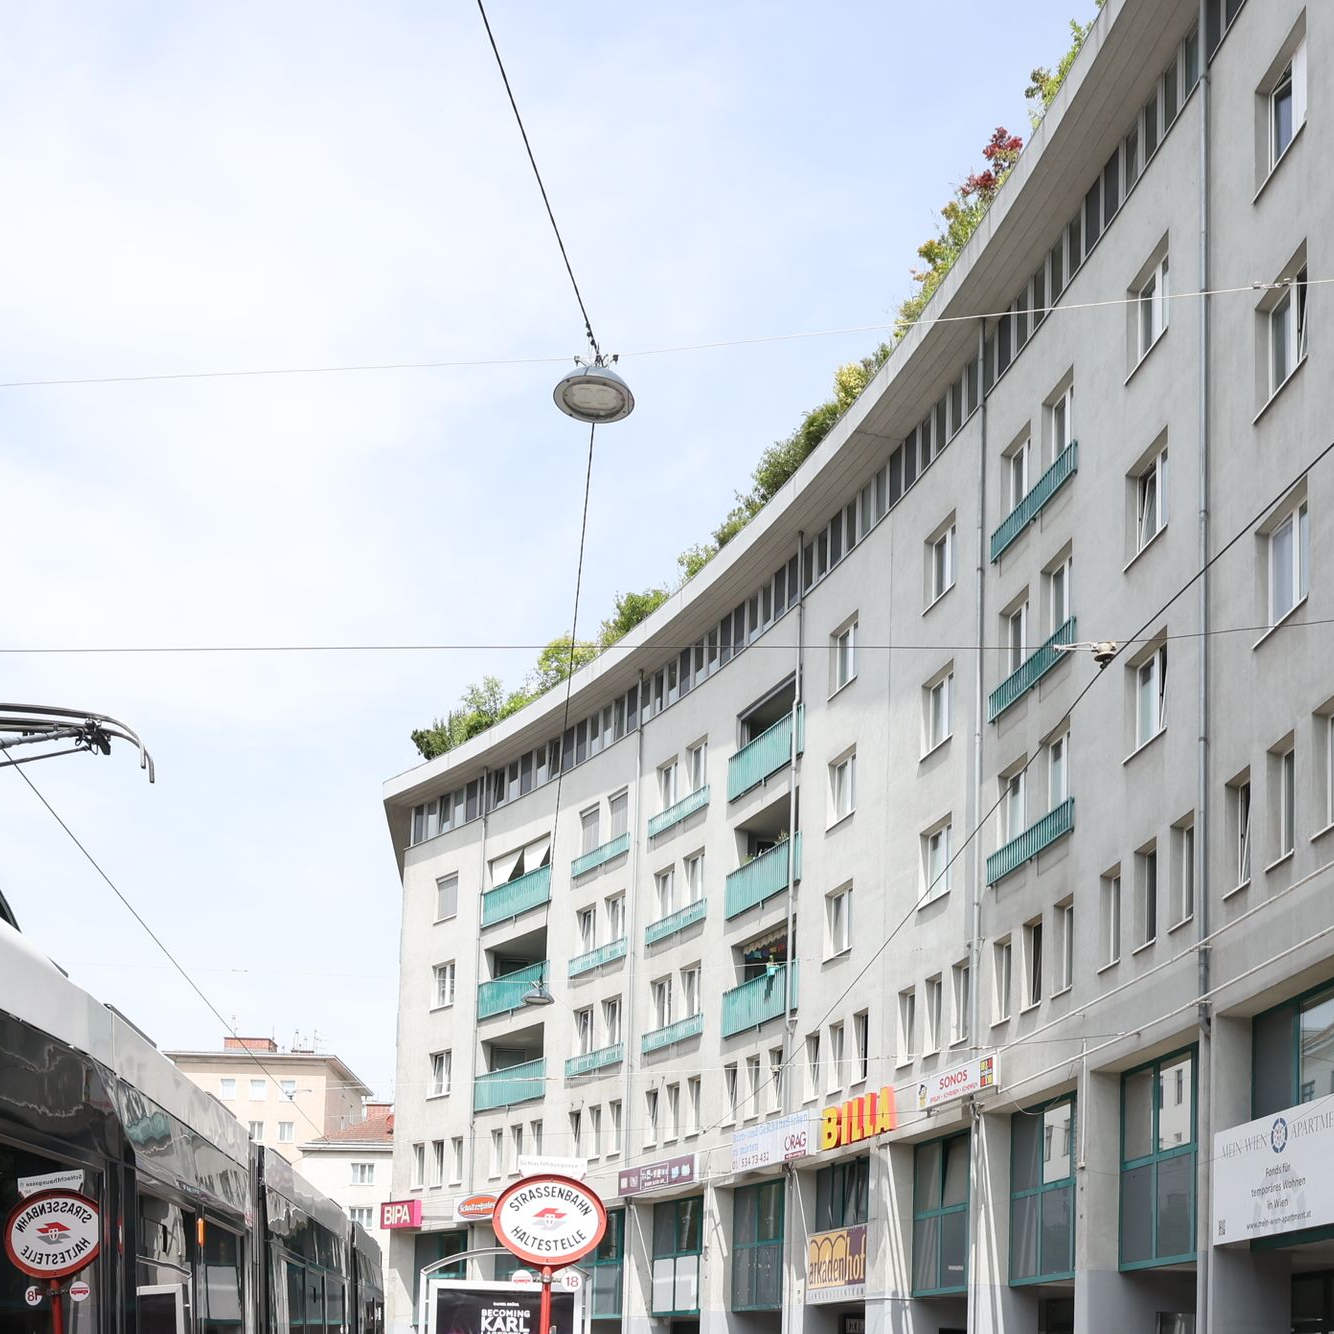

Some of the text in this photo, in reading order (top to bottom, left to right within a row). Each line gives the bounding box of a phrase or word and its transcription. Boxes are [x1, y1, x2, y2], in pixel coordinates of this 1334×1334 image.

[939, 1069, 968, 1090] SONOS
[822, 1086, 895, 1150] BILLA
[1265, 1162, 1291, 1177] Fonds für
[1251, 1177, 1306, 1198] temporäres Wohnen
[509, 1186, 593, 1216] STRASSENBAHN
[1267, 1198, 1289, 1210] in Wien
[383, 1204, 410, 1225] BIPA
[511, 1226, 587, 1251] HALTESTELLE
[565, 1276, 579, 1287] 18
[481, 1309, 531, 1318] BECOMING
[481, 1316, 530, 1332] KARL
